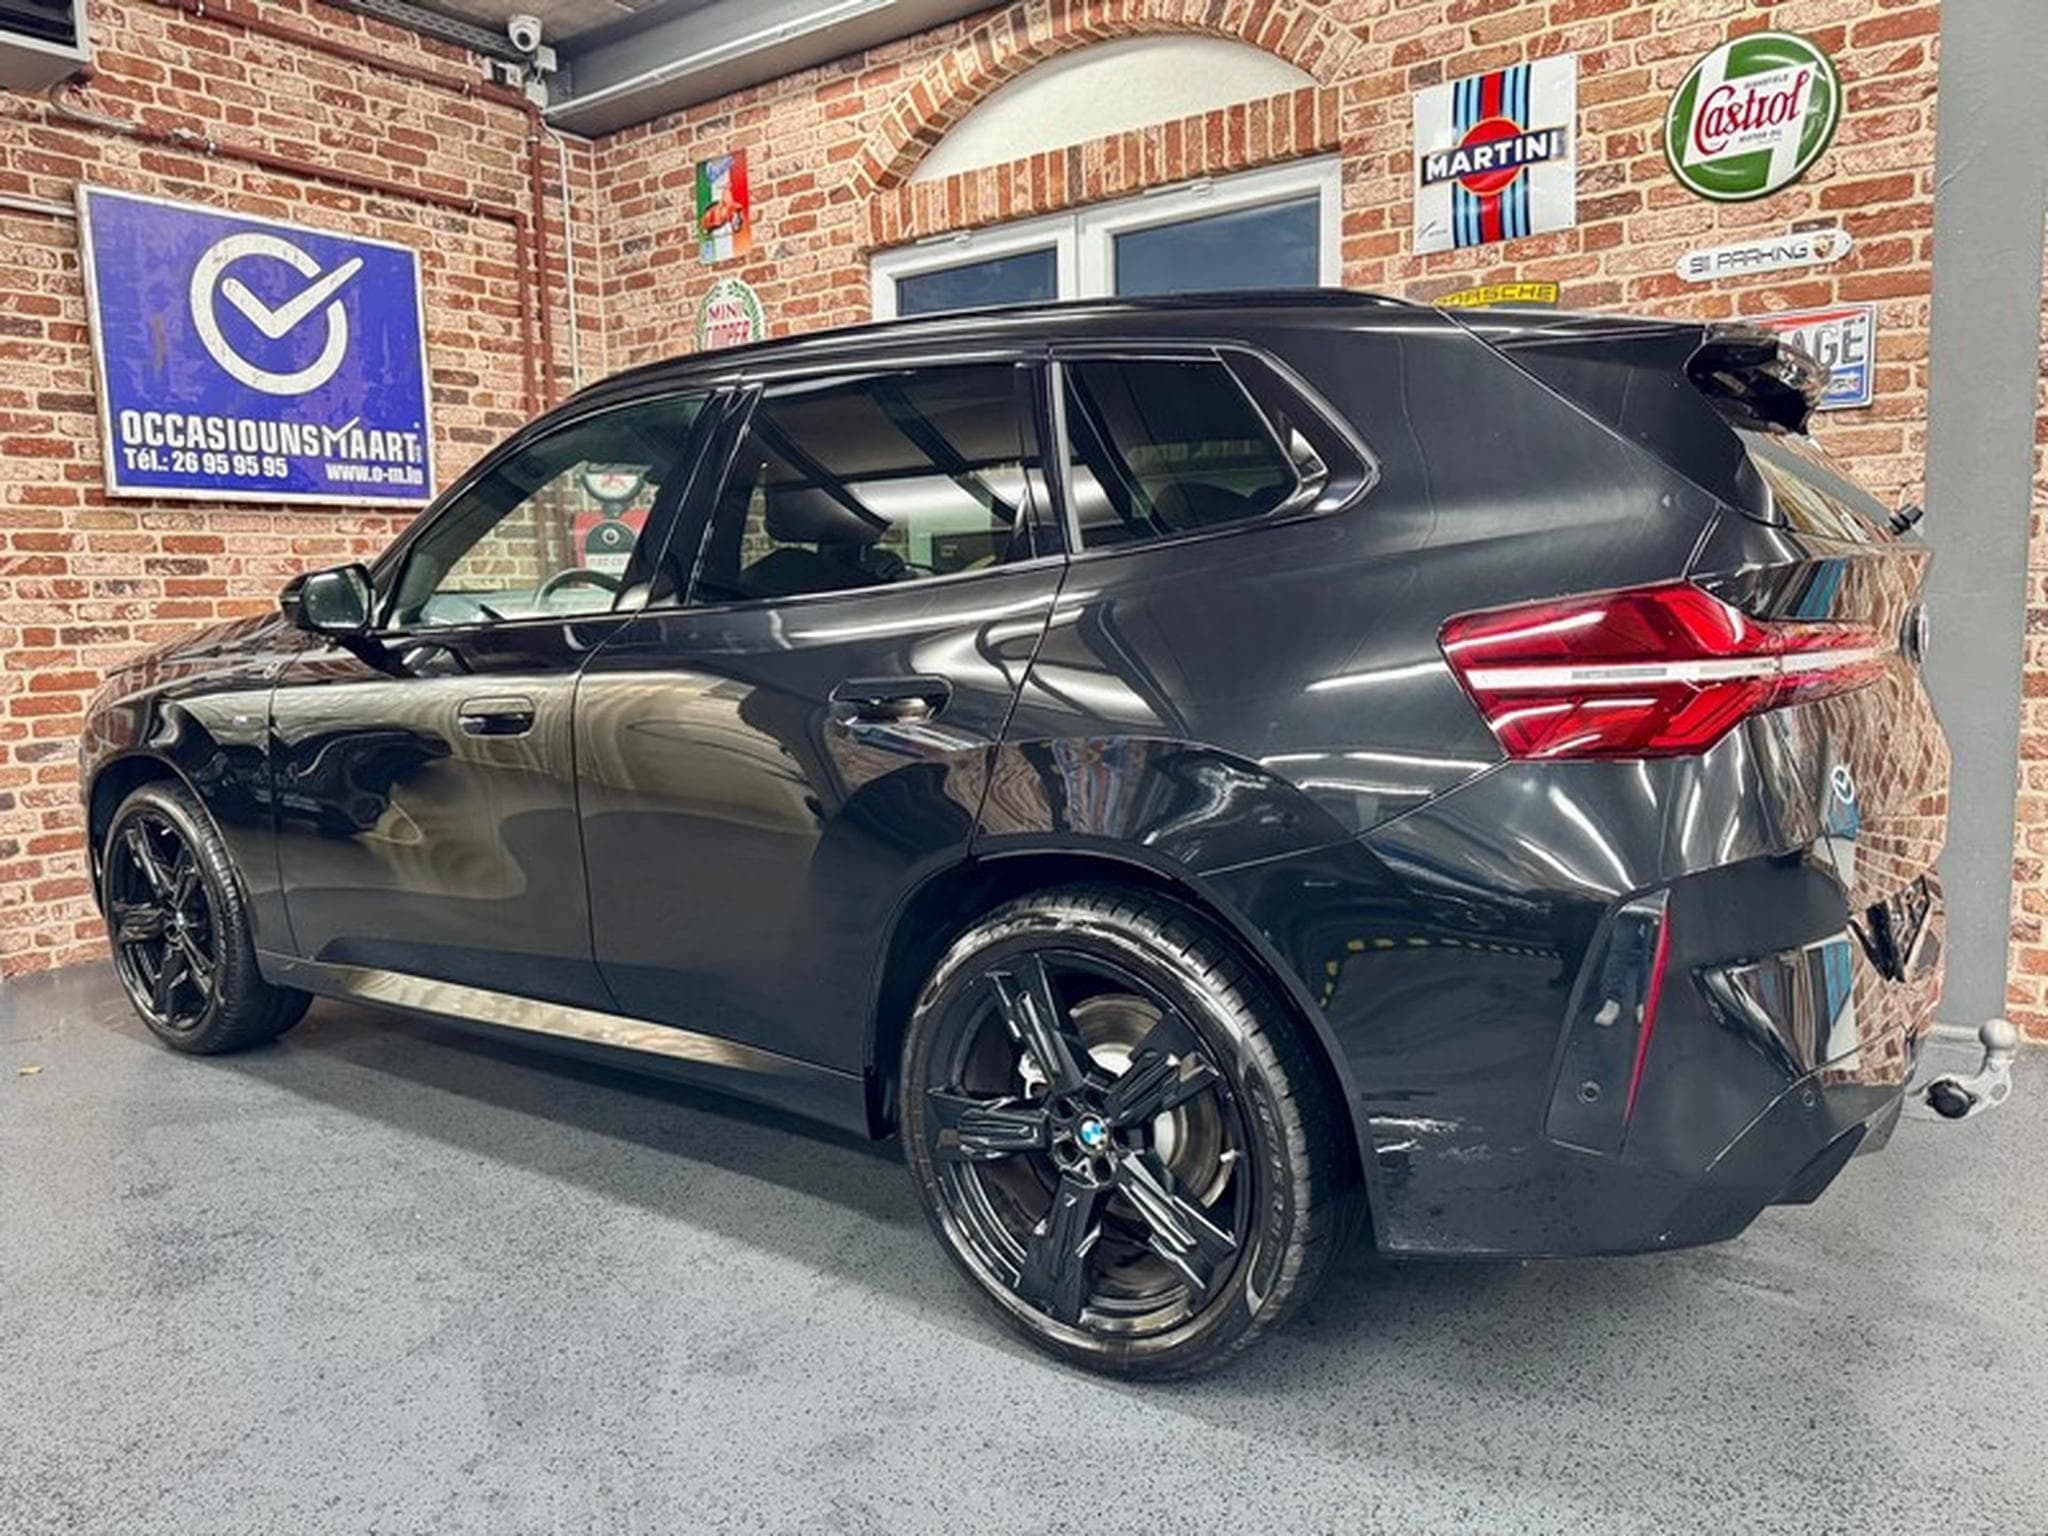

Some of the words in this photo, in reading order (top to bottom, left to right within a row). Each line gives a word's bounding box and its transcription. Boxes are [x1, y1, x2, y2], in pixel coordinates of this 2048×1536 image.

[1694, 70, 1810, 156] Castrol
[1426, 131, 1559, 181] MARTINI
[1717, 246, 1808, 268] PARKING
[120, 409, 418, 463] OCCASIOUNSMAART
[123, 448, 169, 472] Tél.:
[171, 451, 199, 474] 26
[202, 453, 230, 475] 95
[233, 454, 259, 477] 95
[262, 456, 288, 478] 95
